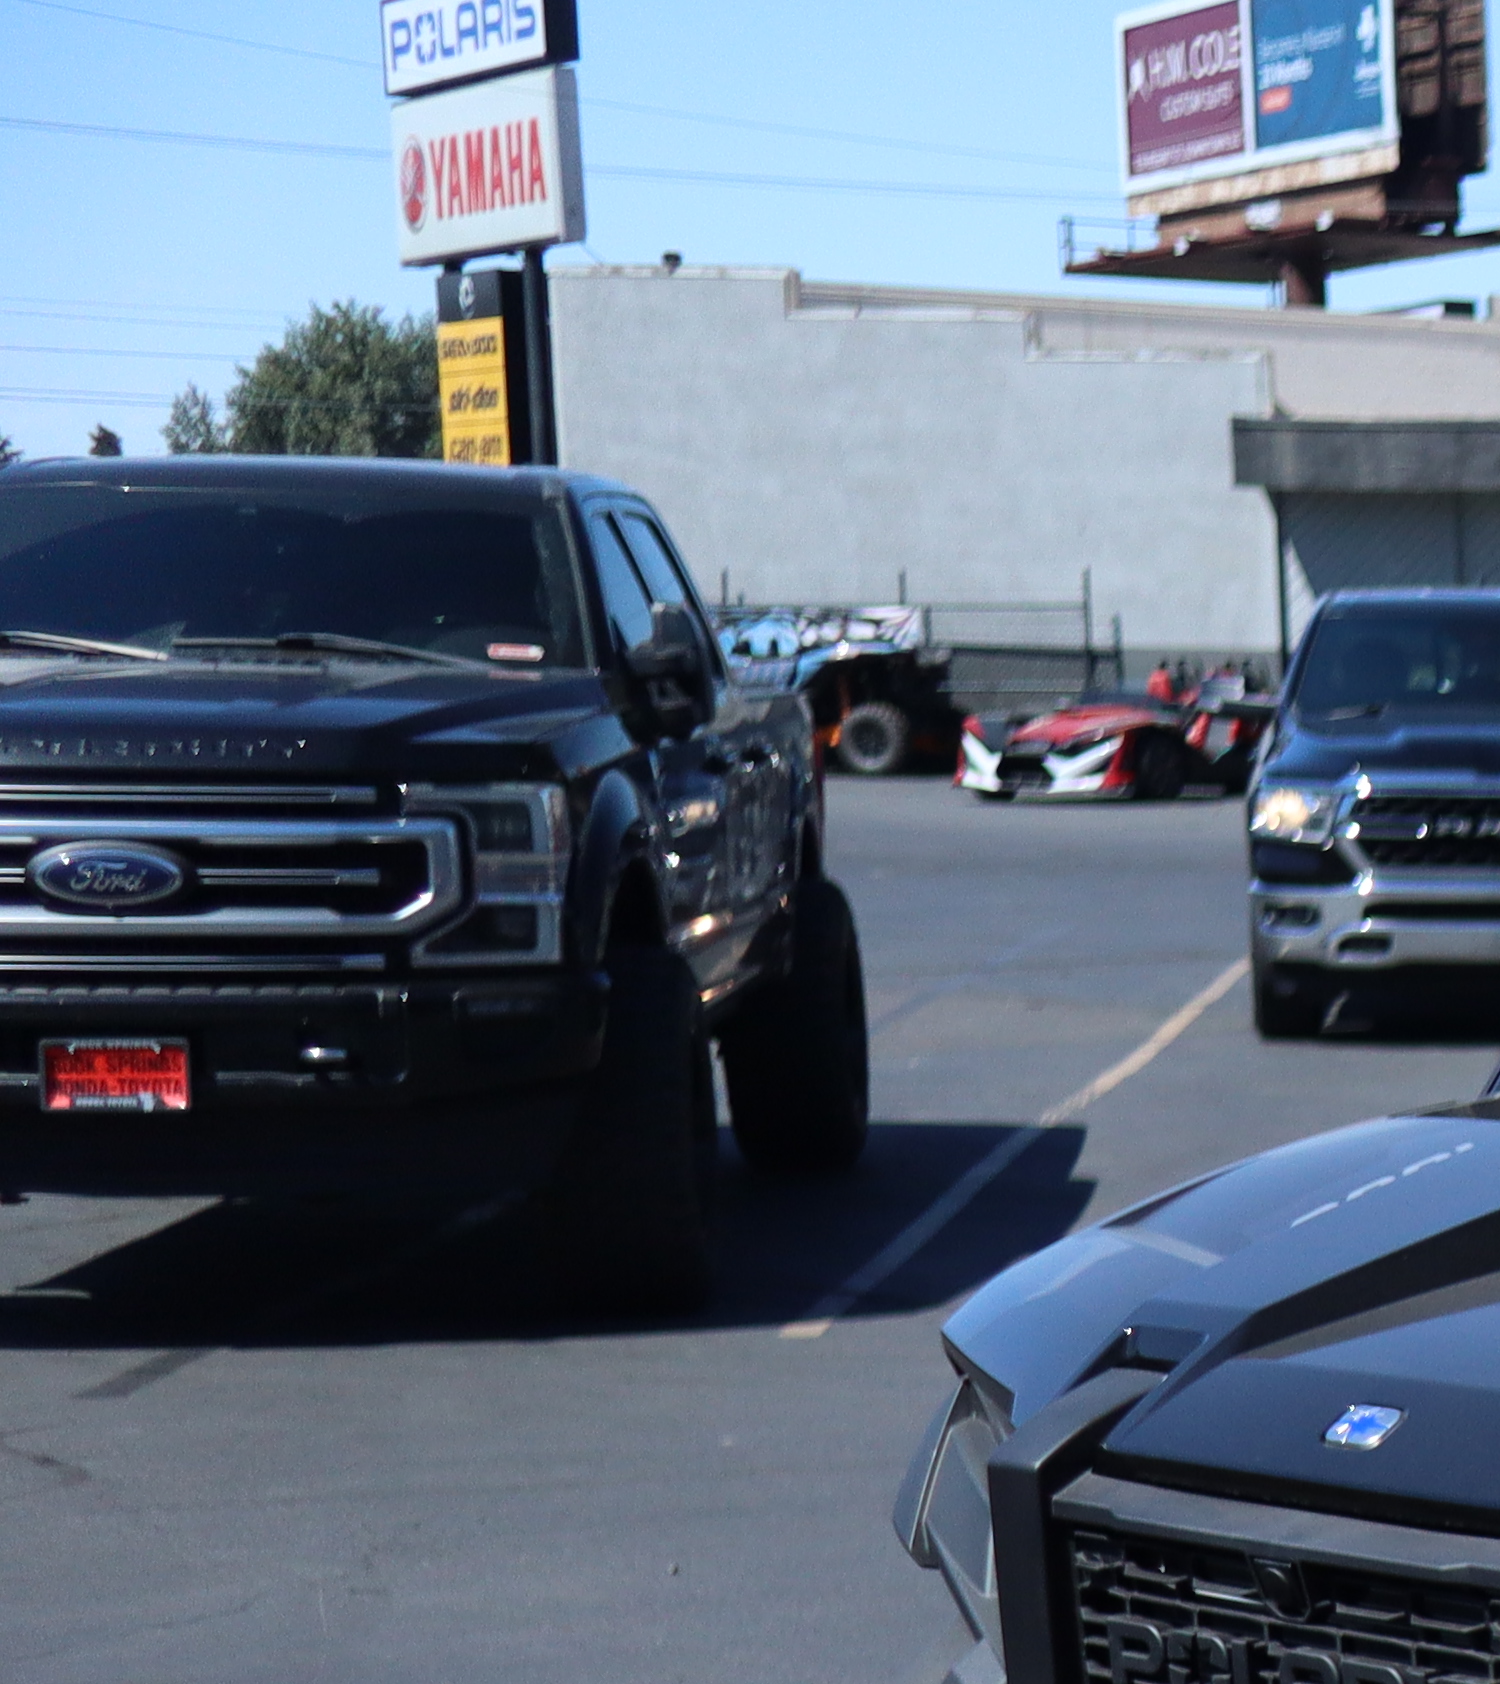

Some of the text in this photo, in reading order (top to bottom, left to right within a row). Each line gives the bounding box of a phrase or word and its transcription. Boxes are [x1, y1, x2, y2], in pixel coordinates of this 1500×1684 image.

[390, 0, 537, 72] POLARIS
[429, 117, 547, 219] YAMAHA
[70, 861, 147, 893] Ford
